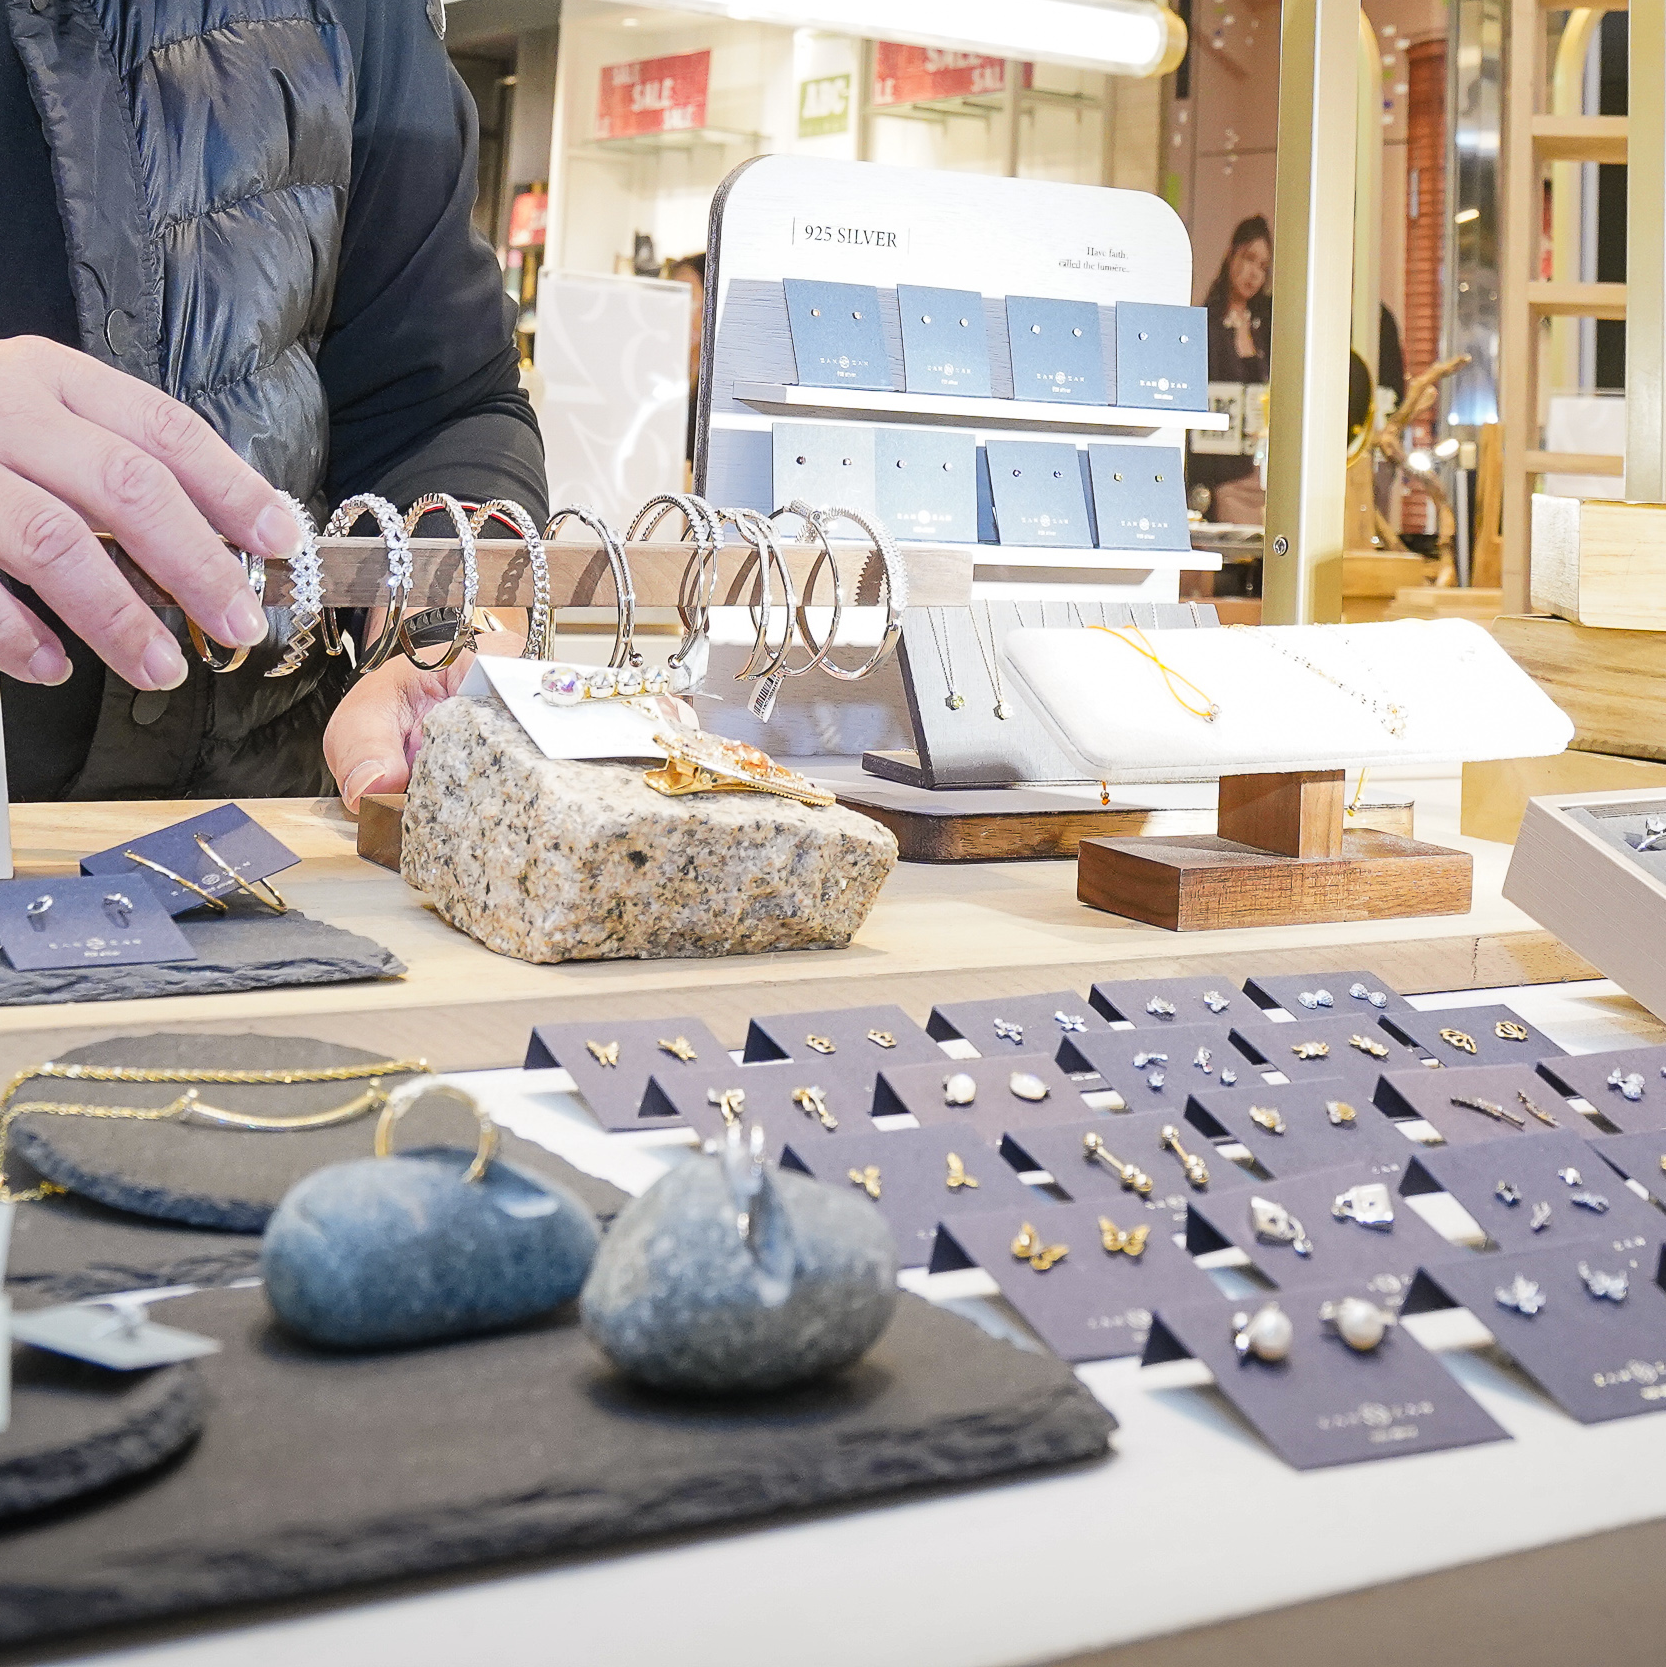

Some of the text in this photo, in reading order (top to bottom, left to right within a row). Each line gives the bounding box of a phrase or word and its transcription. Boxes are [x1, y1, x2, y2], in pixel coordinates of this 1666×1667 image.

[632, 76, 675, 113] SALE
[804, 224, 898, 249] 925 SILVER
